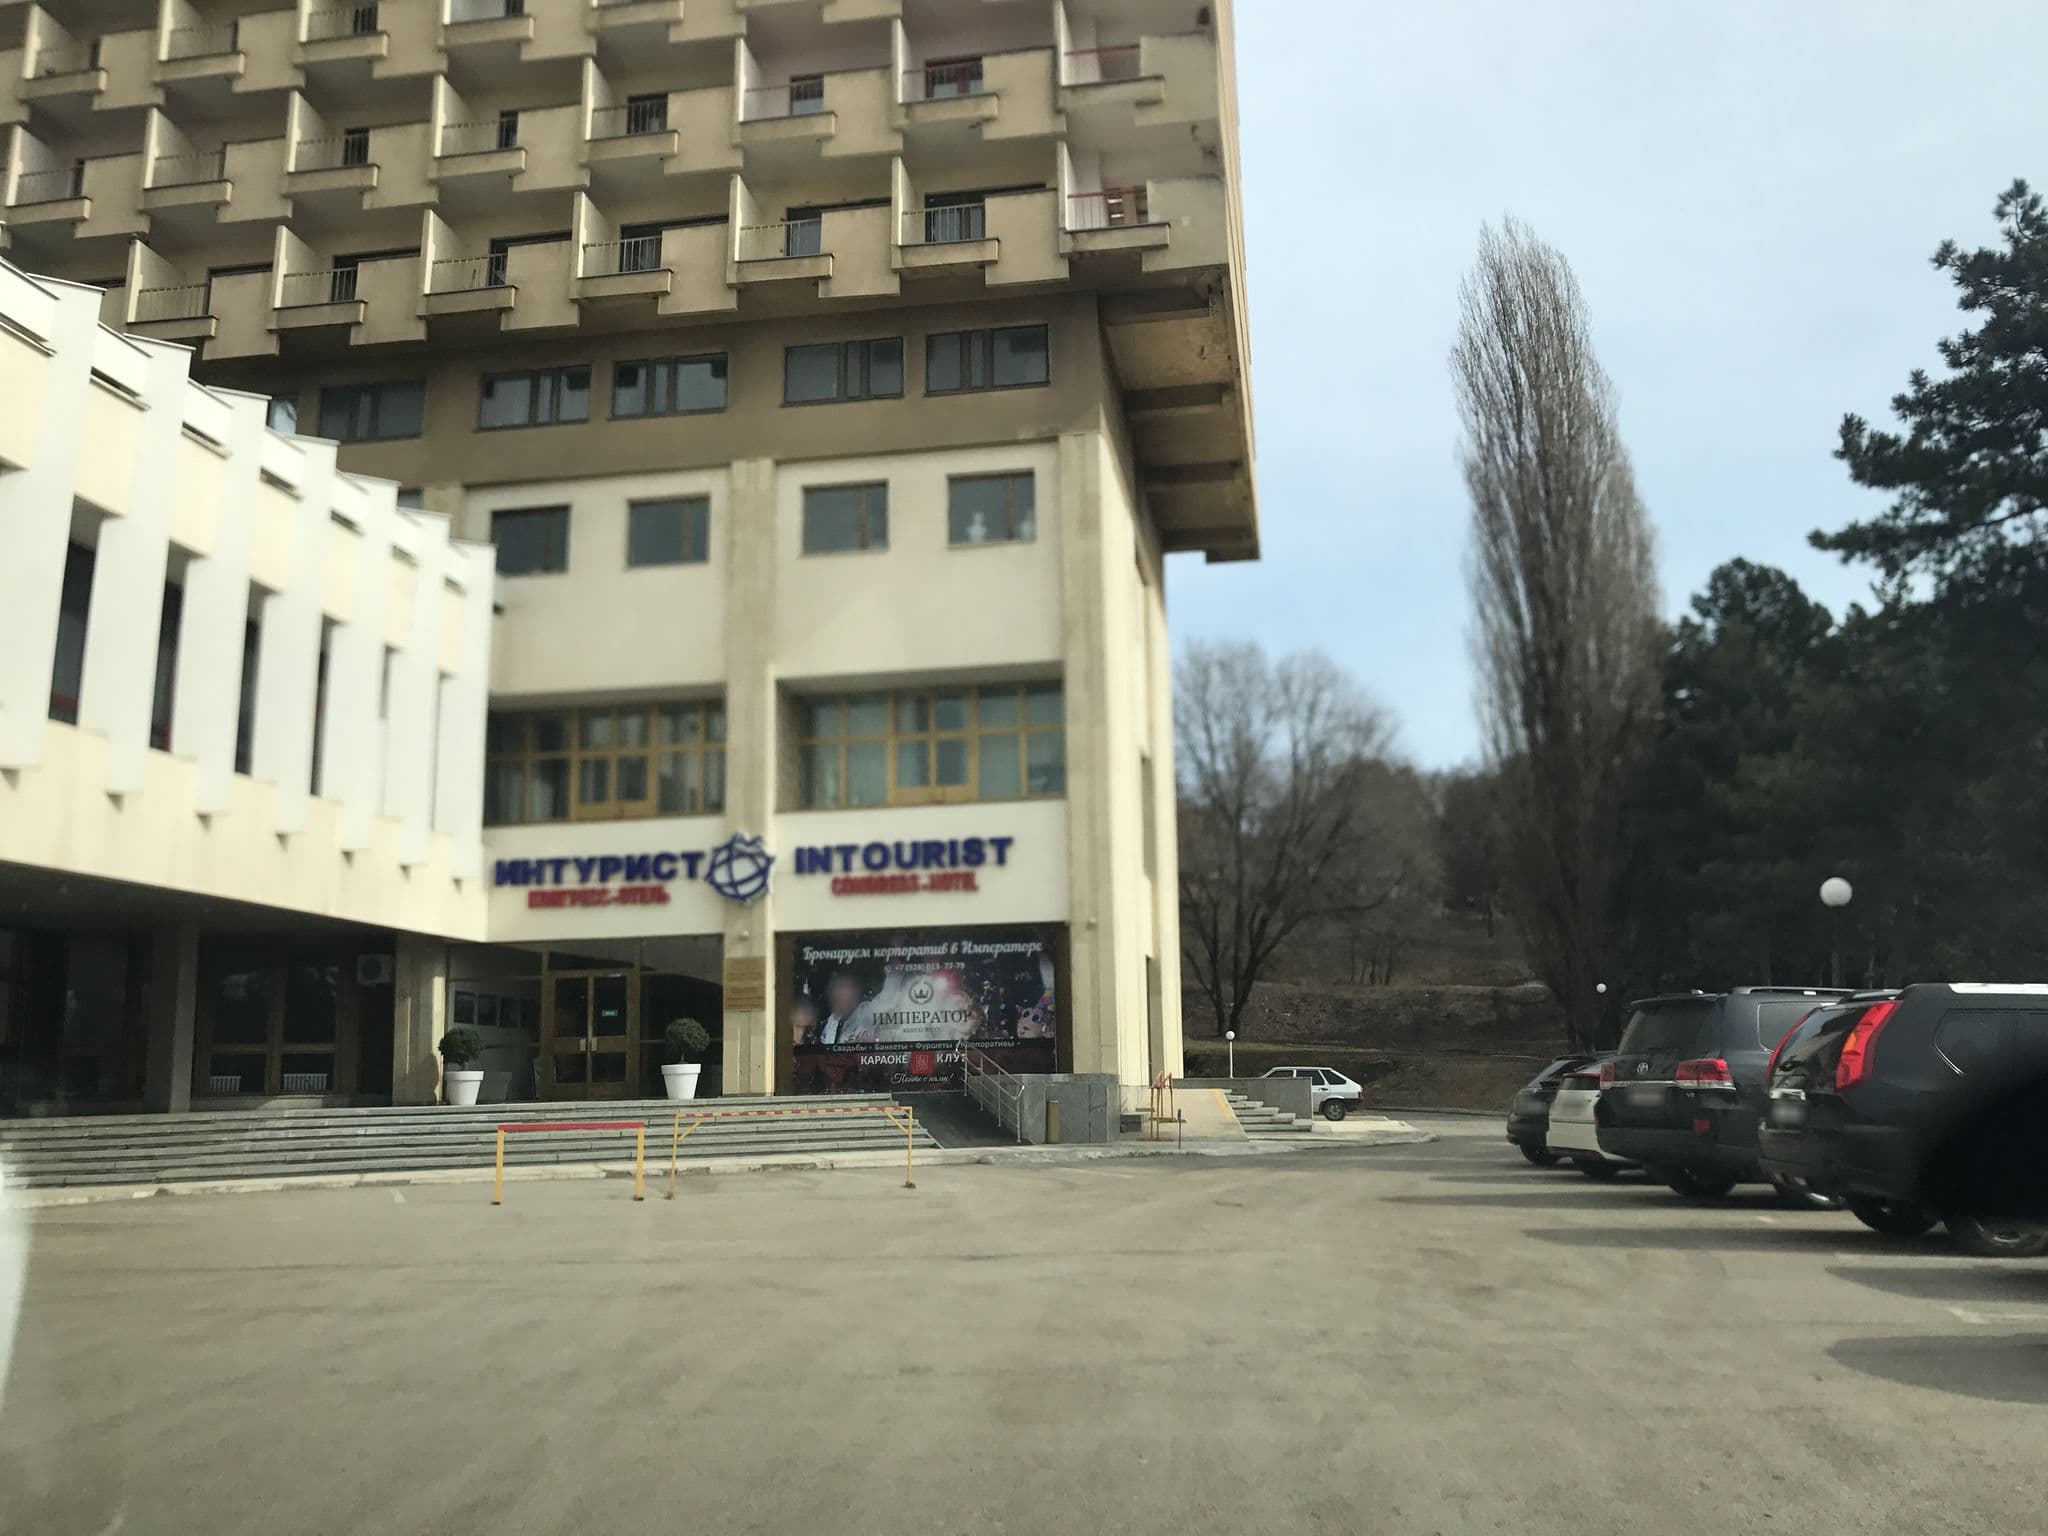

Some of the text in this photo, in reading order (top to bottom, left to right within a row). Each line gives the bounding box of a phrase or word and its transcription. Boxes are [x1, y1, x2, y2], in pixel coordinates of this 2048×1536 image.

[794, 836, 1014, 875] INTOURIST
[495, 851, 705, 886] ИНТУРИСТ
[803, 940, 1043, 965] Бронируем корпоратив в Императоре
[872, 1009, 972, 1025] ИМПЕРАТОР
[832, 1043, 867, 1052] Свадьбы
[875, 1043, 908, 1051] Банкеты
[915, 1042, 952, 1050] Фуршеты
[860, 1054, 908, 1065] КАРАОКЕ
